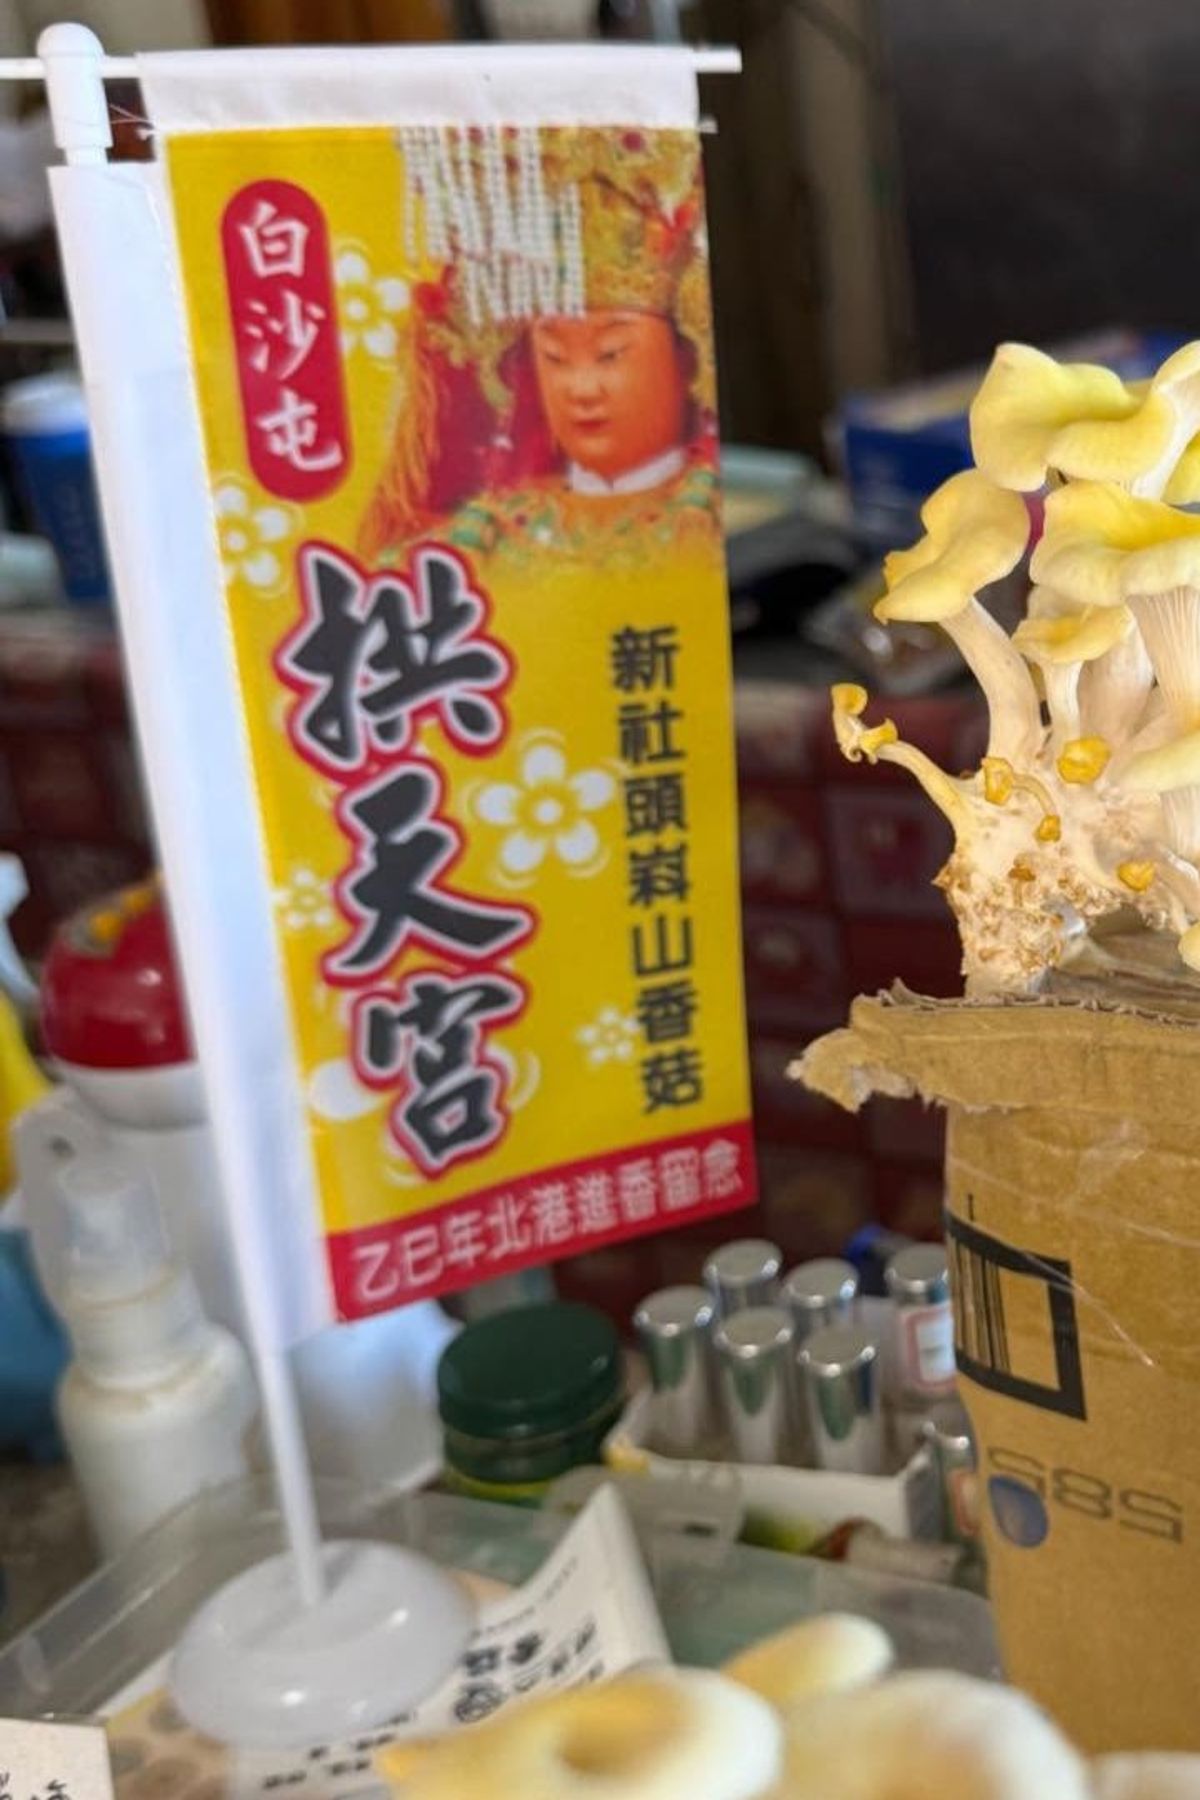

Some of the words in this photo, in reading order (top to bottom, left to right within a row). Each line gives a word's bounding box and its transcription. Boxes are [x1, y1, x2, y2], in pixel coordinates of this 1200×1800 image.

[238, 200, 343, 473] 白沙屯
[284, 550, 528, 1163] 拱天宮
